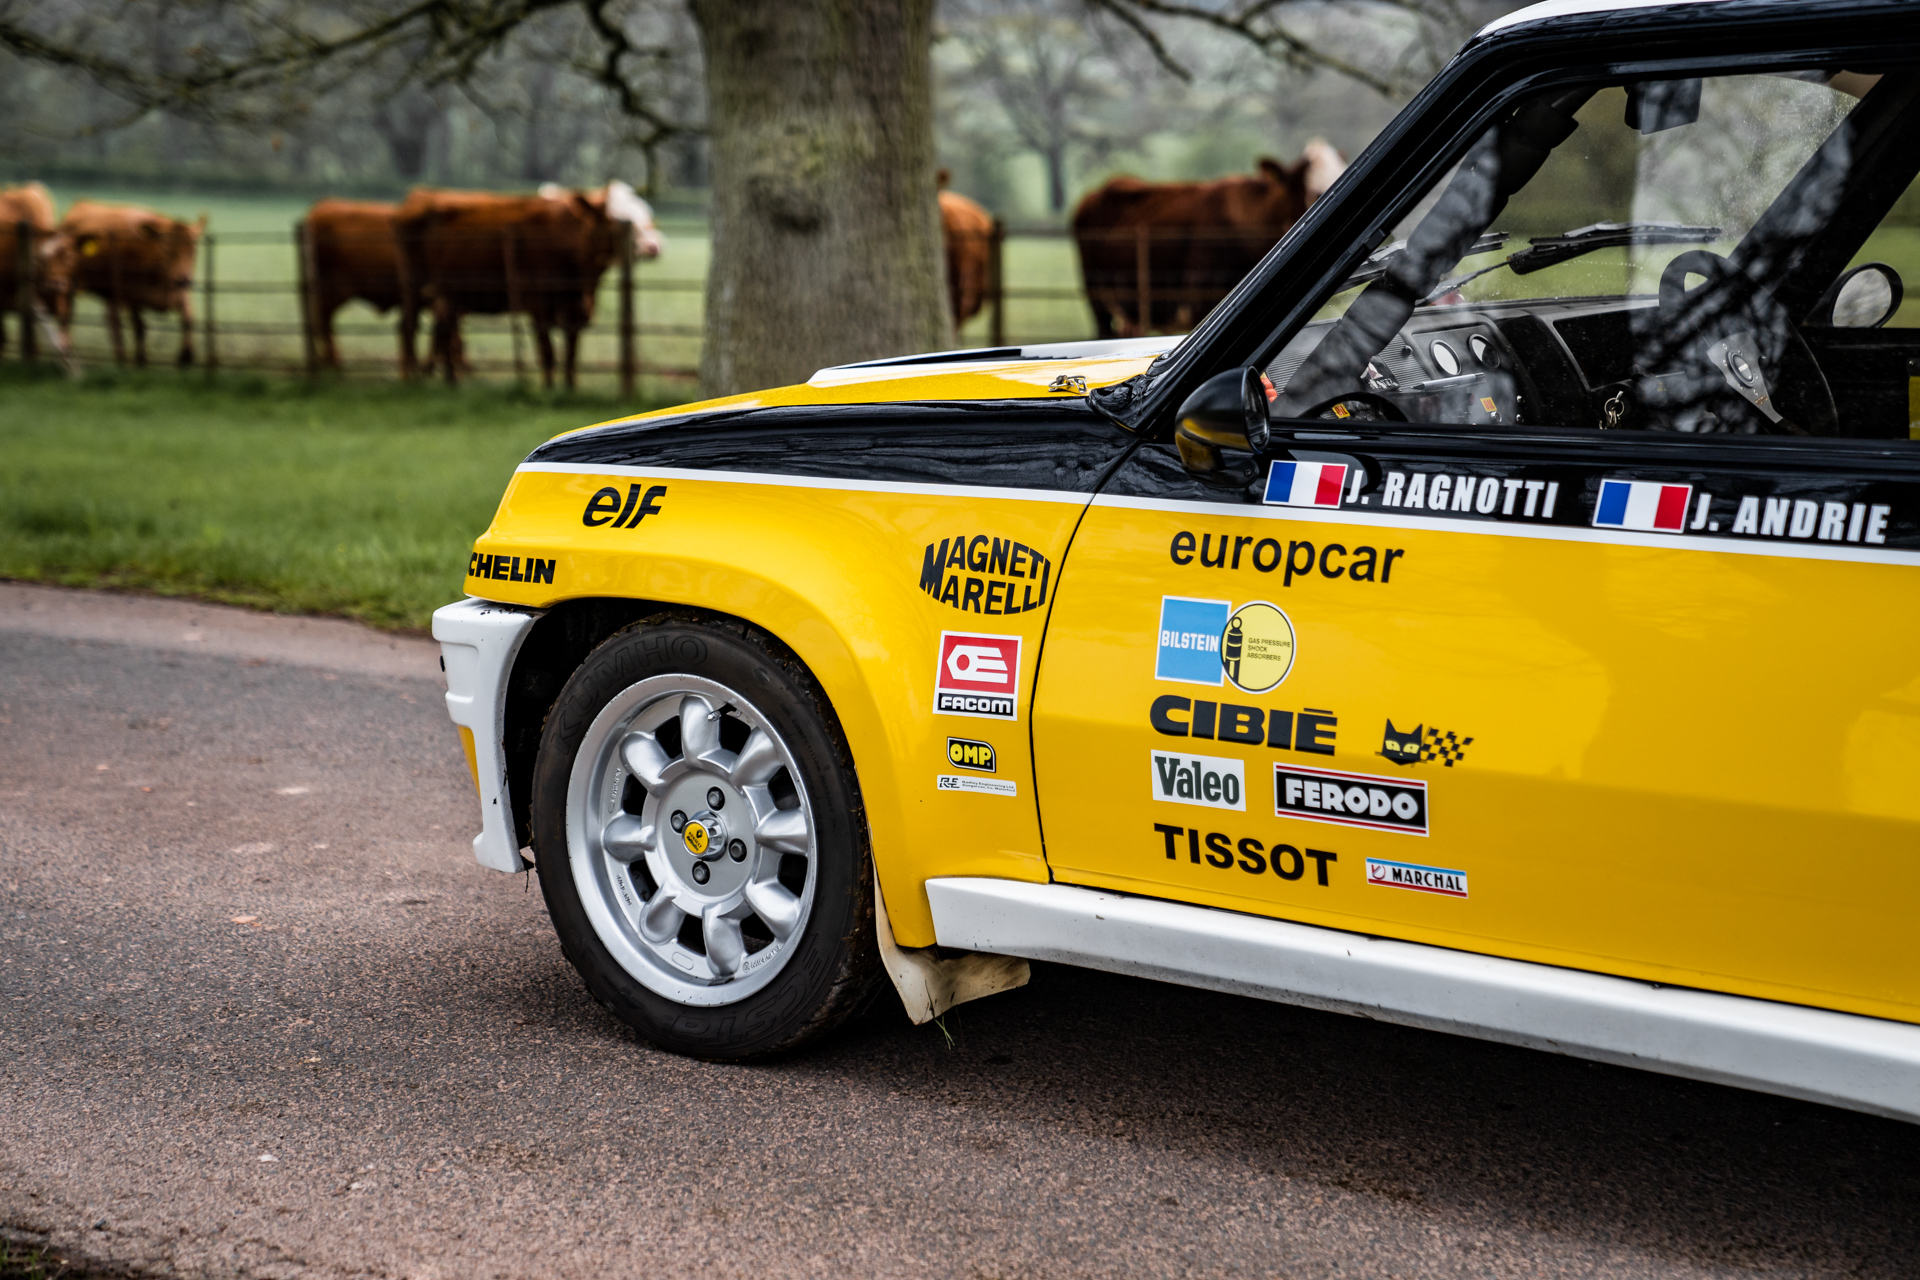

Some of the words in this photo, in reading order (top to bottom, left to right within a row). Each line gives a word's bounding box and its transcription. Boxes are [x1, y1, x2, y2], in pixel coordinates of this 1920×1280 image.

[582, 483, 668, 529] elf
[1345, 469, 1369, 504] J.
[1381, 471, 1559, 518] RAGNOTTI
[1690, 492, 1719, 532] J.
[1732, 495, 1891, 544] ANDRIE
[919, 534, 1051, 592] MAGNETI
[1169, 530, 1405, 588] europcar
[919, 568, 1049, 616] MARELLI
[1161, 630, 1219, 652] BILSTEIN
[1246, 652, 1281, 662] ABSORBERS
[1247, 645, 1268, 653] SHOCK
[1248, 637, 1261, 645] GAS
[1261, 638, 1291, 648] PRESSURE
[553, 636, 707, 755] KUMHO
[940, 696, 1011, 713] FACOM
[950, 743, 992, 766] OMP
[1154, 755, 1241, 806] Valeo
[1285, 777, 1419, 820] FERODO
[1153, 822, 1338, 887] TISSOT
[1392, 869, 1464, 892] MARCHAL
